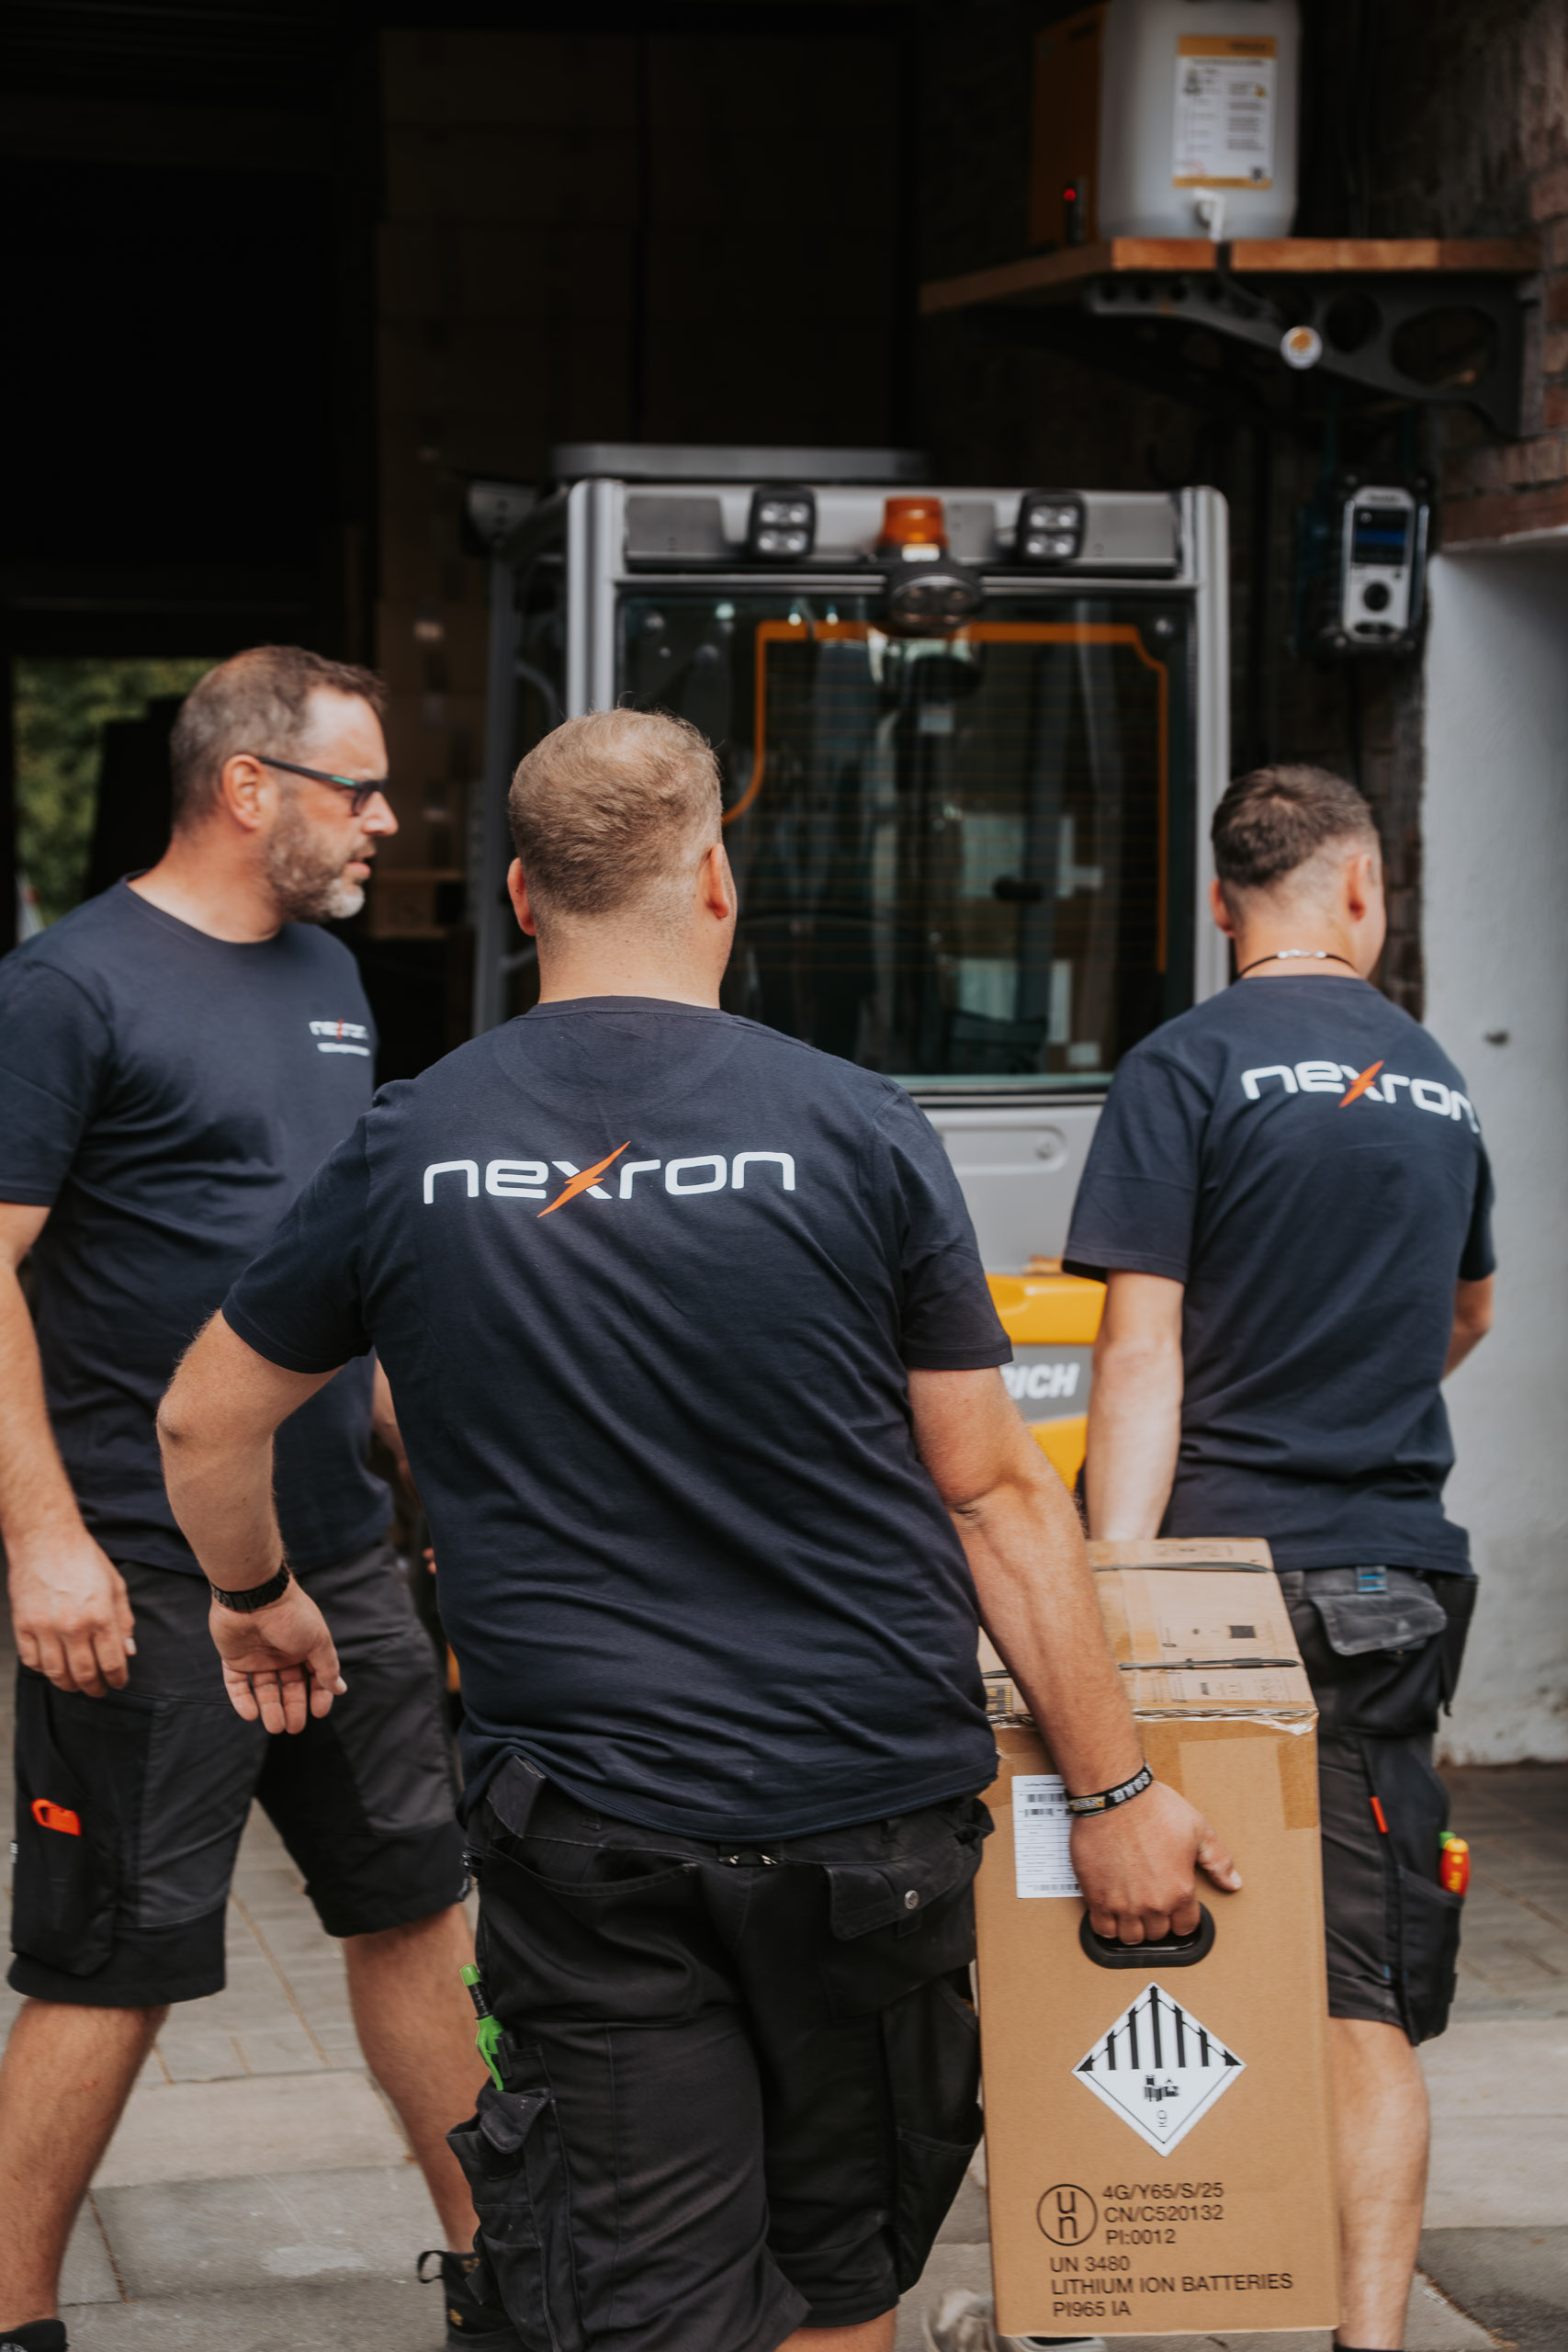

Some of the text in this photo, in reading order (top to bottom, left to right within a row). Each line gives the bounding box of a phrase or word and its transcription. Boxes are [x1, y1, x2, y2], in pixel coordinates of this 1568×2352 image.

[1241, 1060, 1481, 1134] nexron
[423, 1140, 795, 1218] nexron
[1102, 2182, 1224, 2199] 4G/Y65/S/25
[1103, 2204, 1224, 2222] CN/C520132
[1105, 2228, 1177, 2245] PI:0012
[1050, 2256, 1131, 2272] UN 3480
[1051, 2273, 1294, 2295] LITHIUM ION BATTERIES
[1053, 2300, 1133, 2318] PI965 IA
